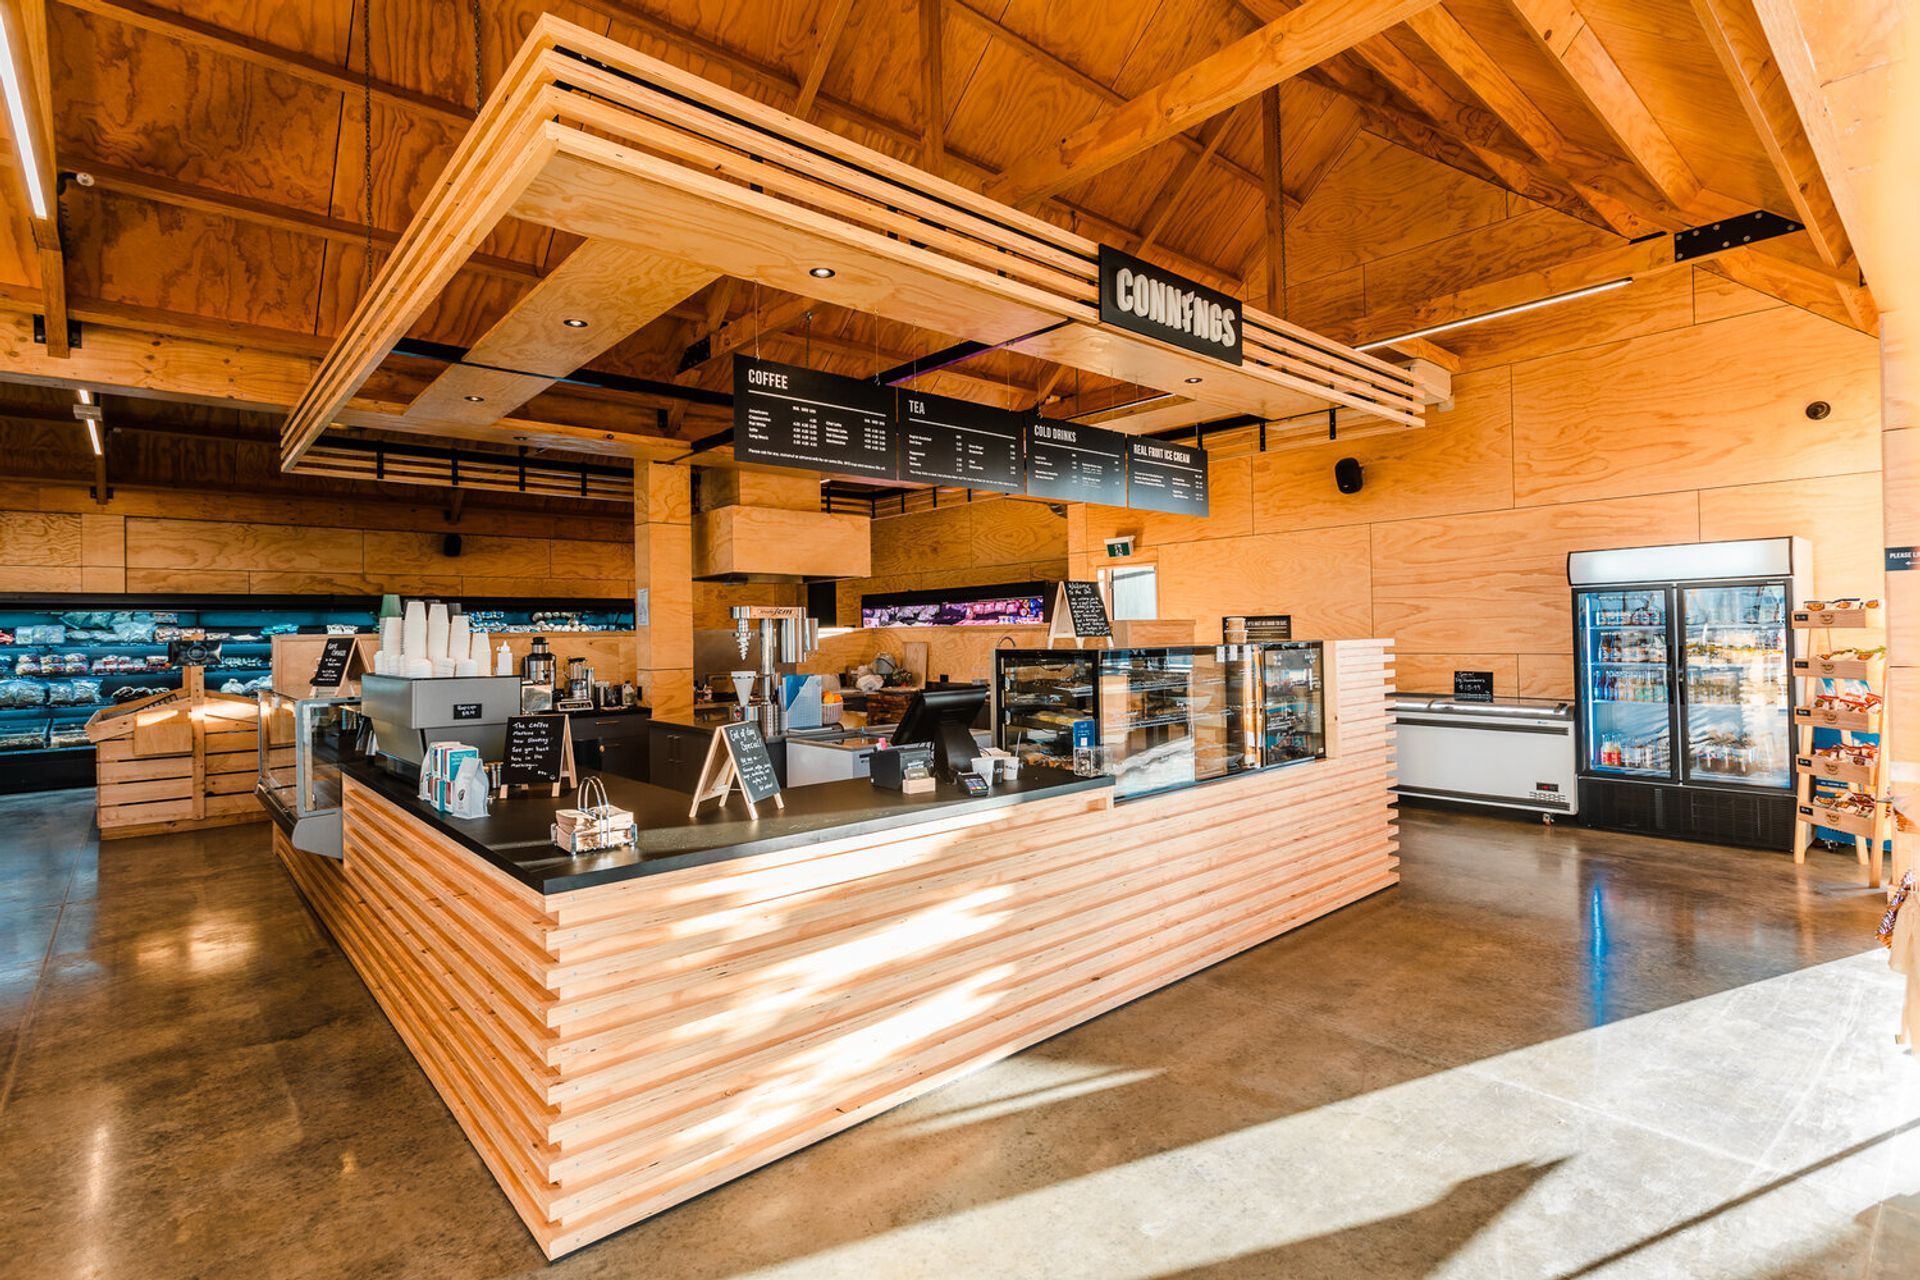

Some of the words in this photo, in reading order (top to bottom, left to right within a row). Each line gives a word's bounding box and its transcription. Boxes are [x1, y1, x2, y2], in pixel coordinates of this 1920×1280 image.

[748, 368, 789, 390] COFFEE
[909, 399, 926, 415] TEA
[1034, 425, 1052, 439] COLD
[1053, 428, 1077, 443] DRINKS
[1133, 444, 1148, 457] REAL
[1148, 446, 1164, 459] FRUIT
[1164, 448, 1173, 461] ICE
[1173, 450, 1191, 464] CREAM
[1889, 551, 1912, 559] PLEASE
